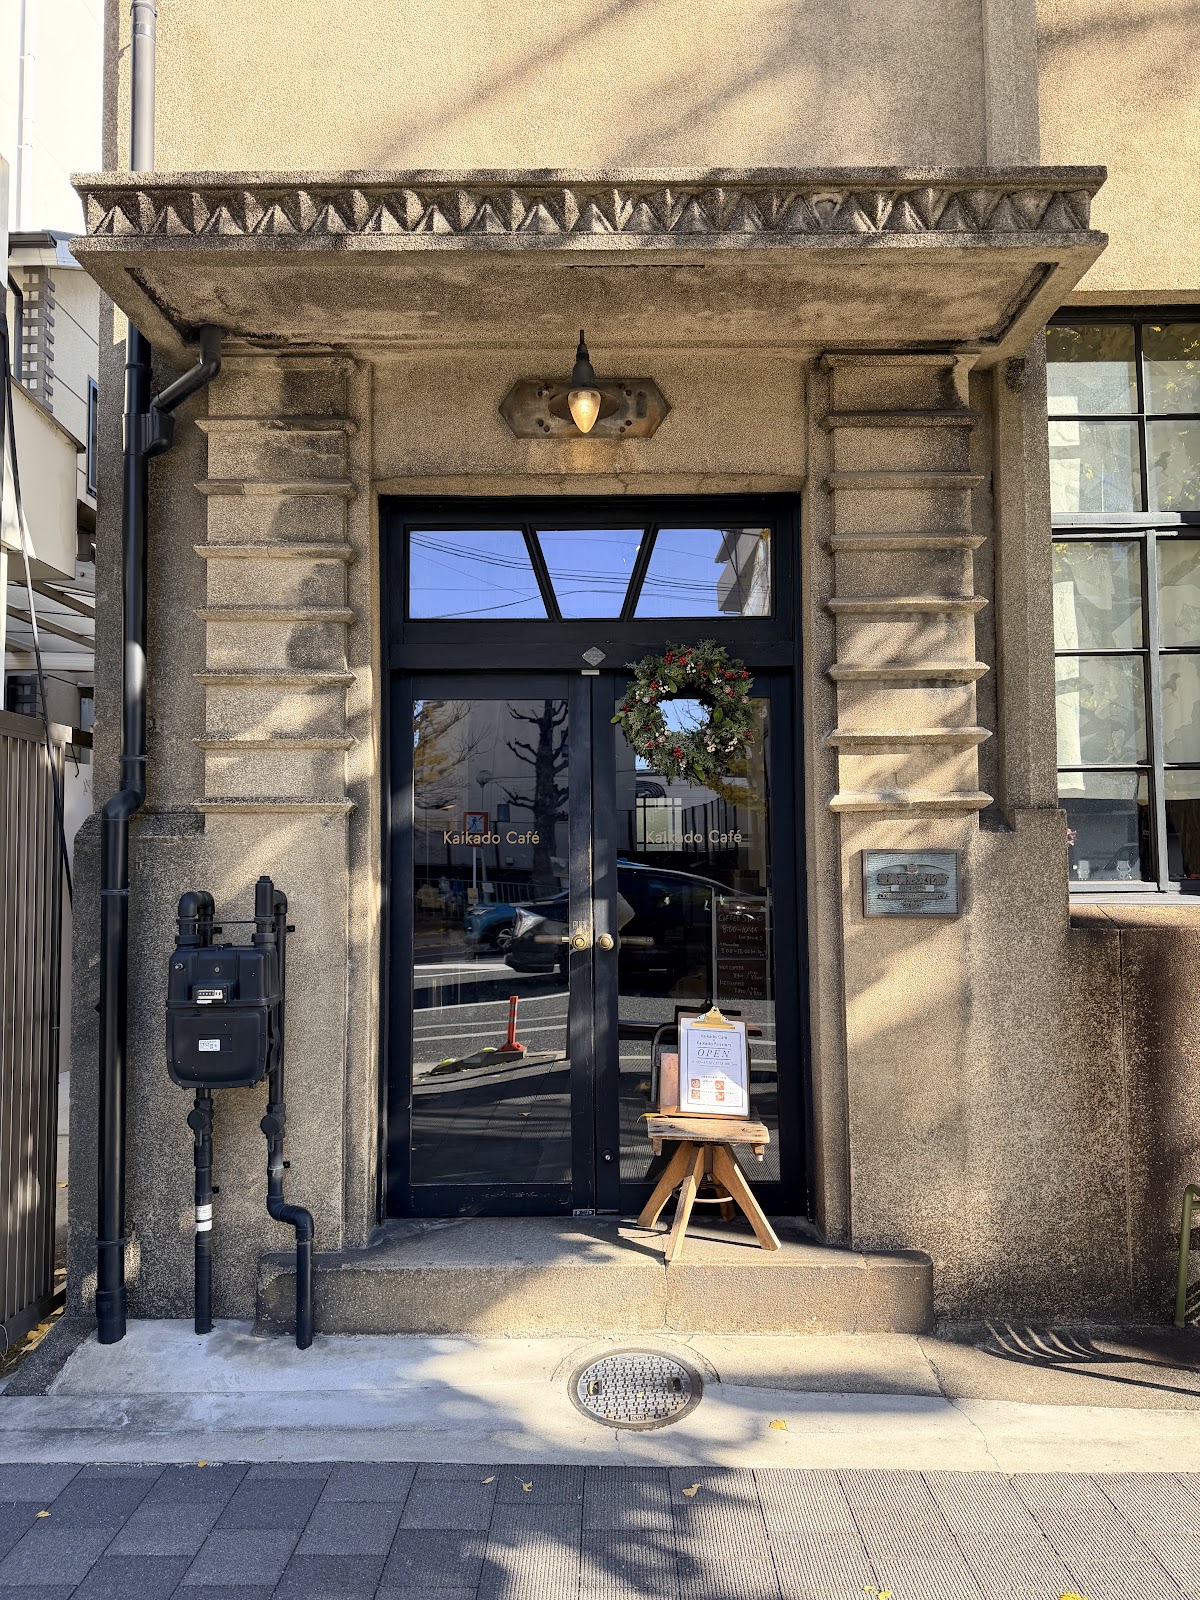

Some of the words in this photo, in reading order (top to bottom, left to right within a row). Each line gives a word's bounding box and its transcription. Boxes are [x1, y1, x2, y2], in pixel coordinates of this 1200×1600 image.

[443, 830, 501, 845] Kaikado
[506, 830, 540, 845] Café
[645, 829, 703, 844] Kaikado
[708, 829, 743, 844] Café
[697, 1048, 731, 1058] OPEN
